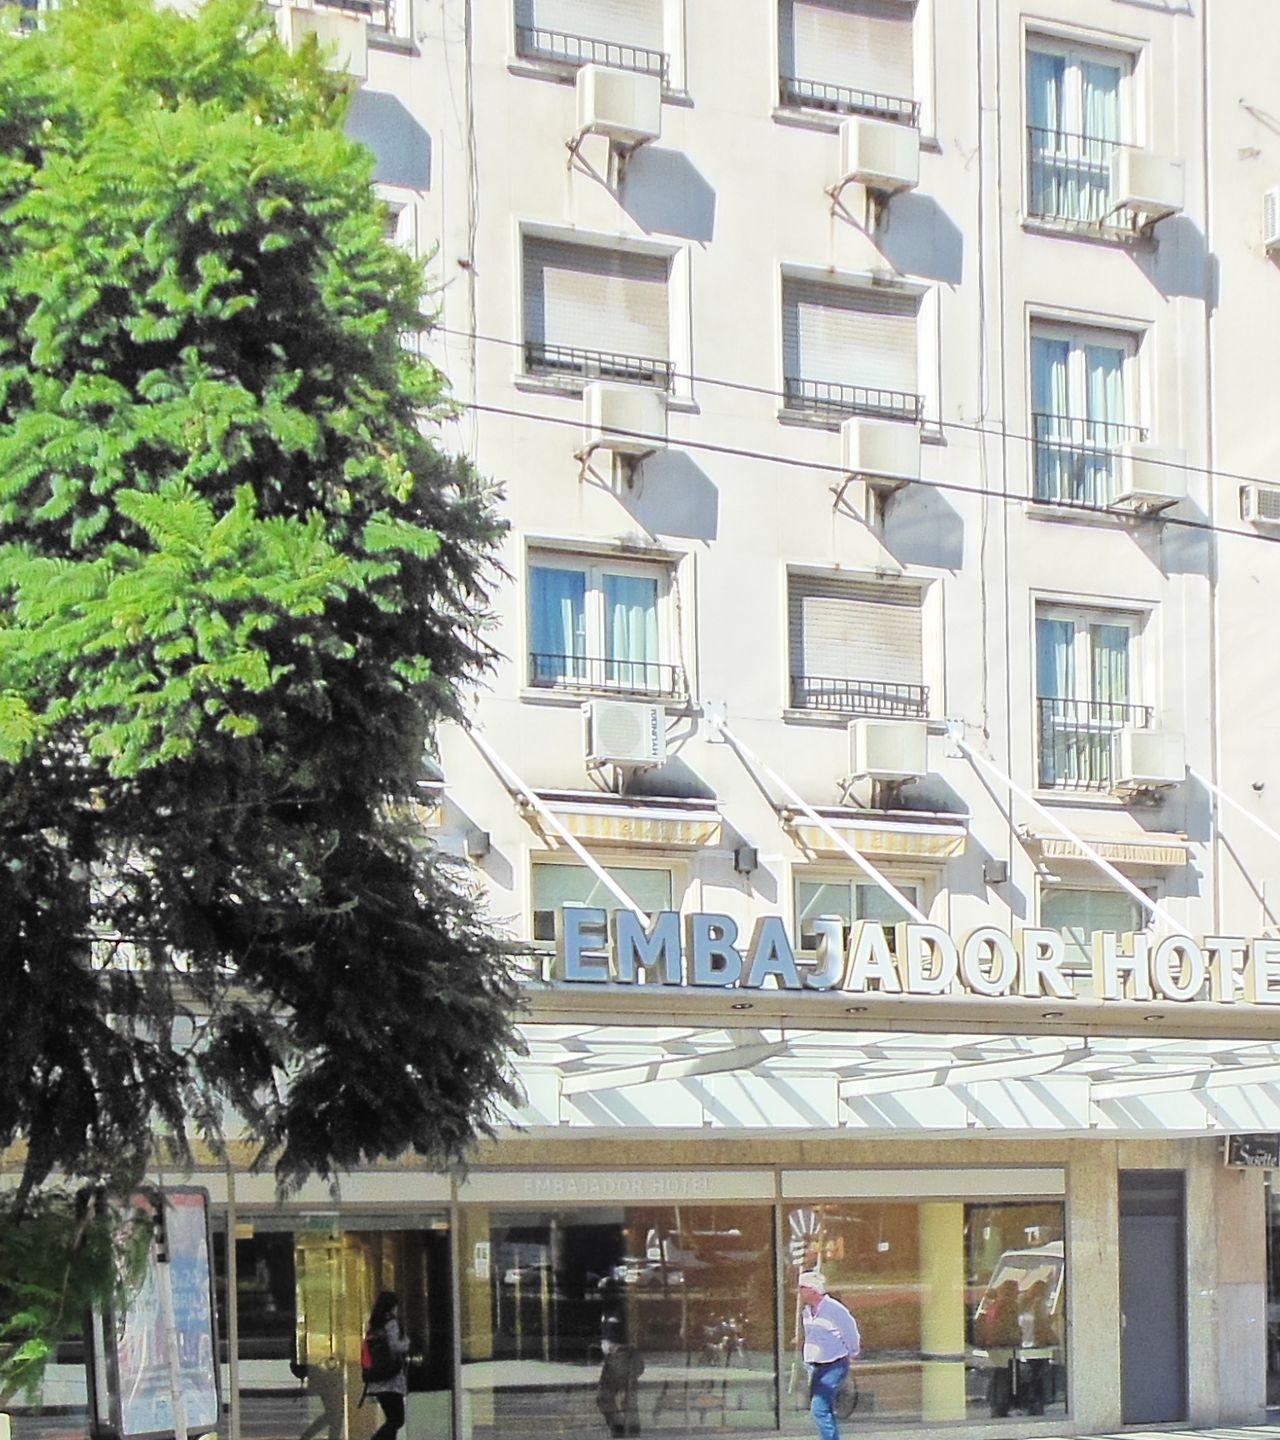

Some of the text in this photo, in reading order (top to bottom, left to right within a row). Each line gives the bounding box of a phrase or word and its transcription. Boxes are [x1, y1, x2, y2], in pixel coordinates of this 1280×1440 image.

[558, 905, 1076, 998] EMBAJADOR
[523, 1177, 713, 1194] EMBAJADOR HOTEL
